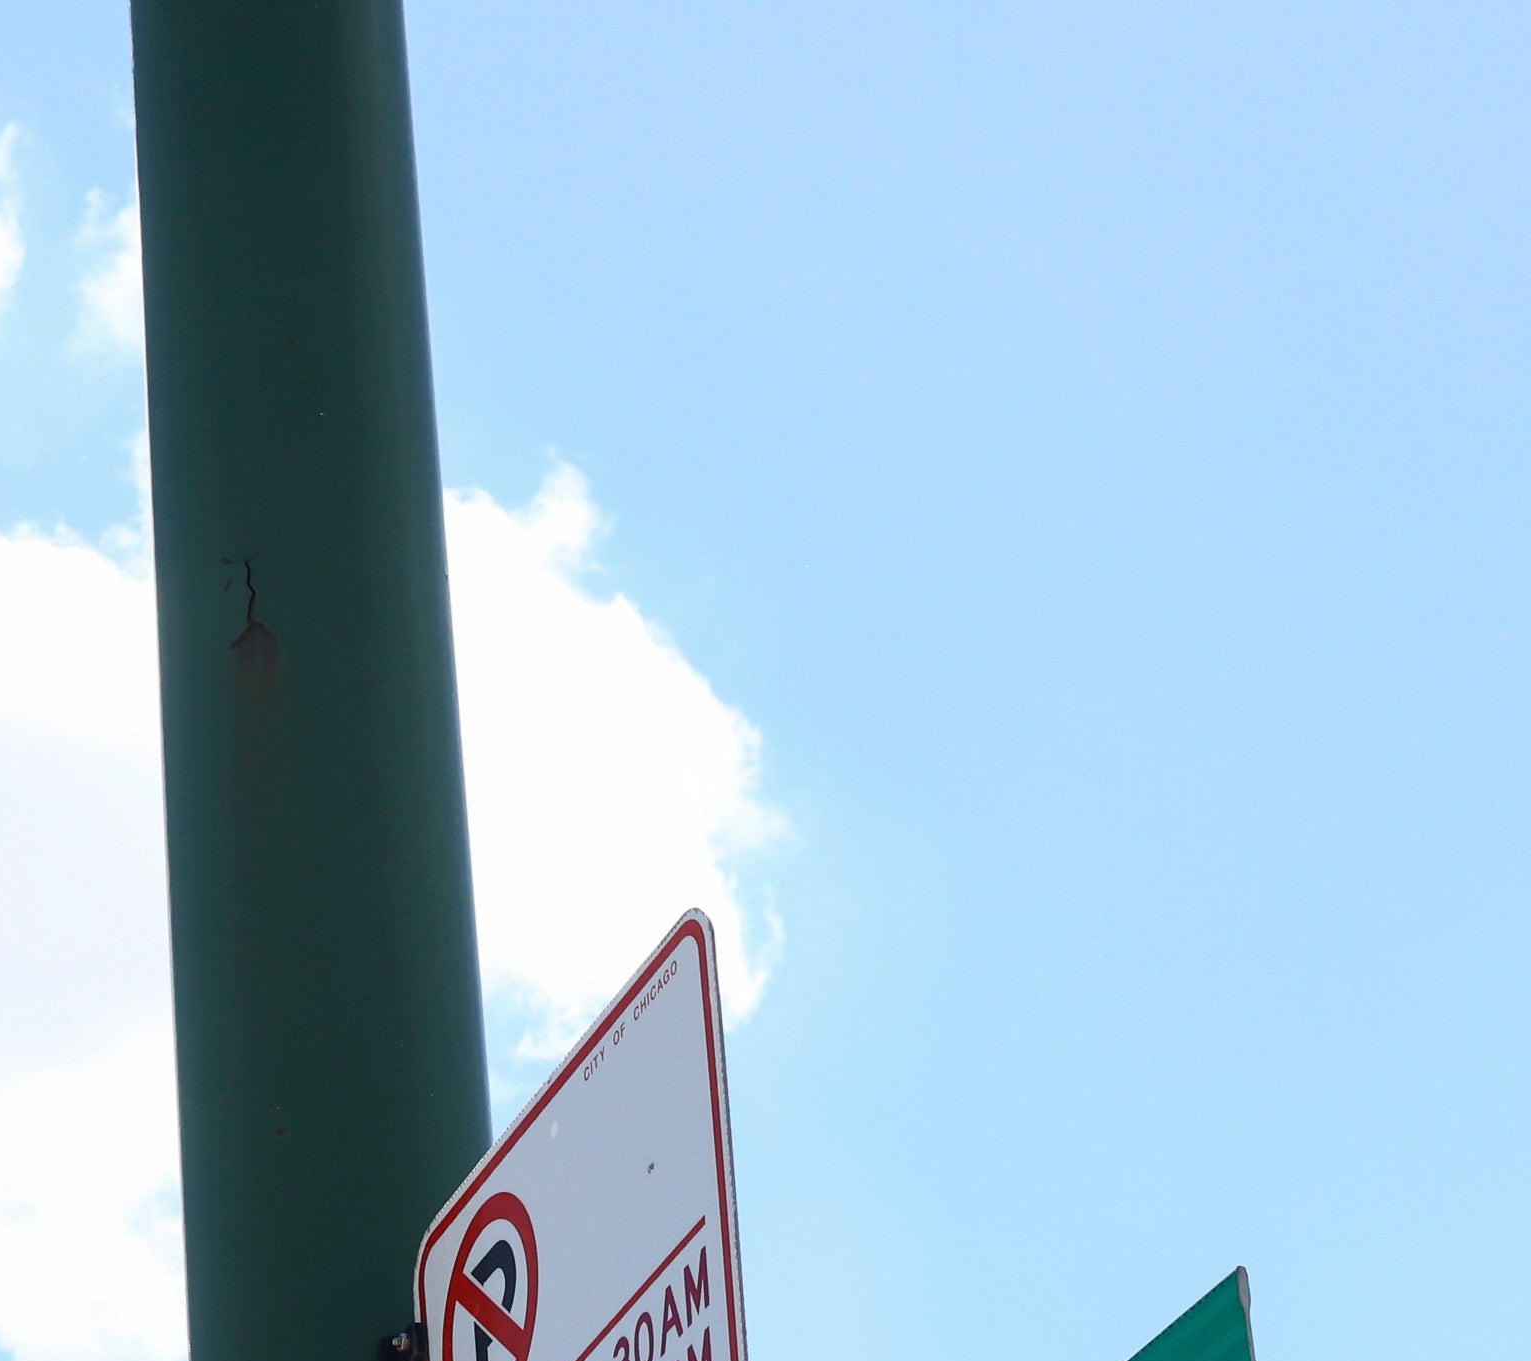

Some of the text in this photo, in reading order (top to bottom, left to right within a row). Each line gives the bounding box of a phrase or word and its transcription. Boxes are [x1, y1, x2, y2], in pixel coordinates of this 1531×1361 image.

[583, 960, 678, 1081] CITY OF CHICAGO
